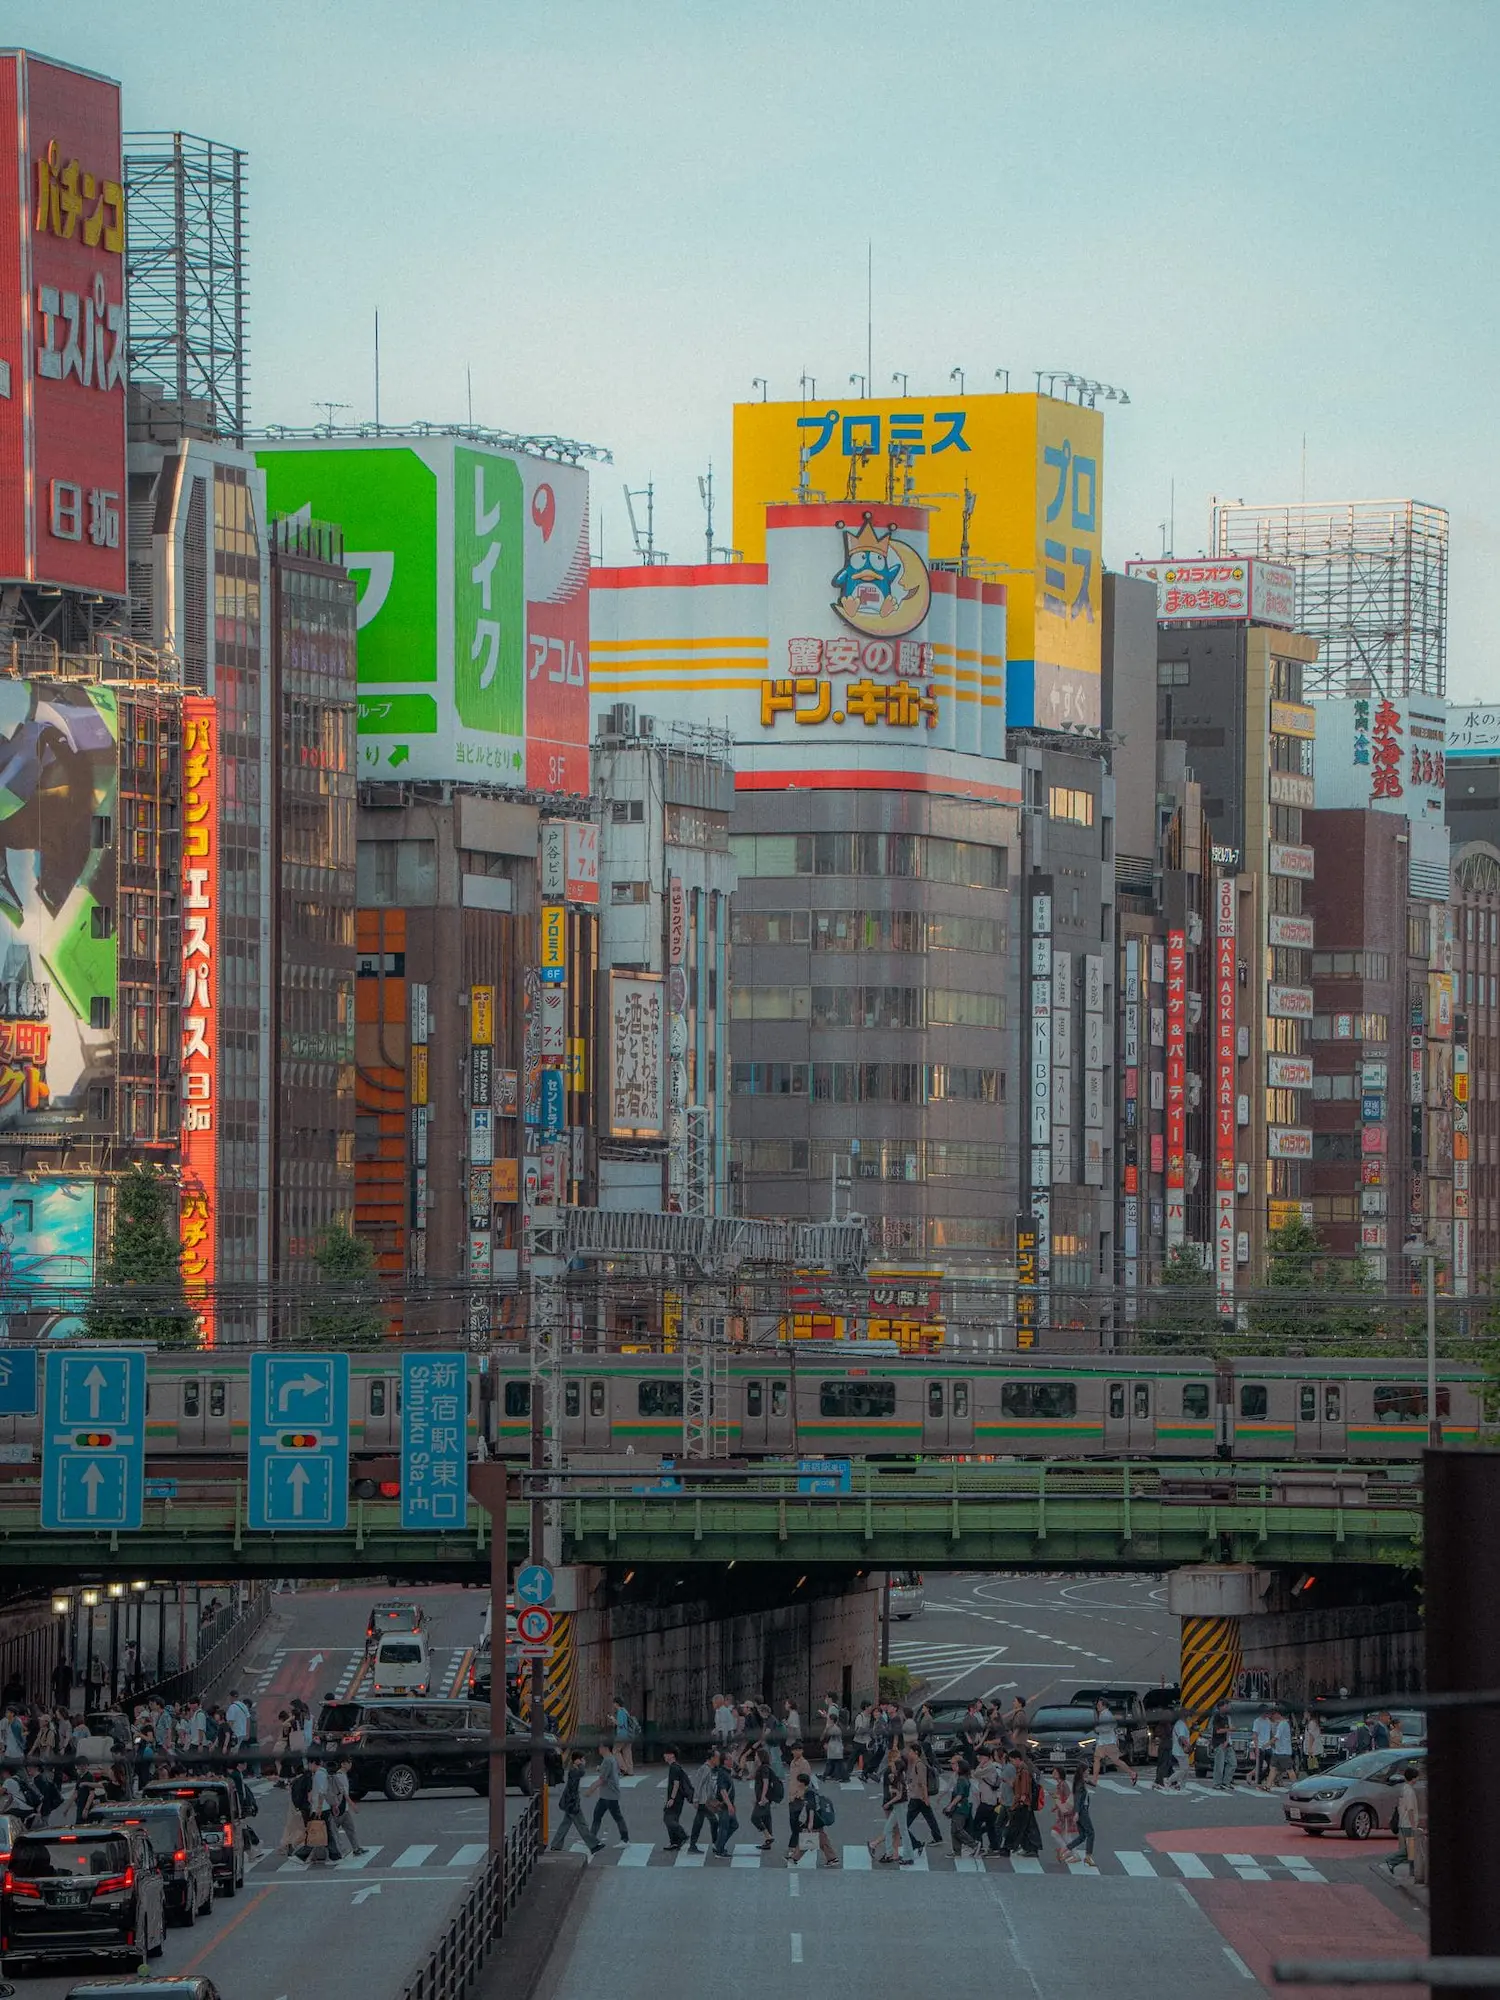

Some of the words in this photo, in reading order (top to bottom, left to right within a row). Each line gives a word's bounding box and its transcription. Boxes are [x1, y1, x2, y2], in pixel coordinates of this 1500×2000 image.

[36, 139, 124, 253] パチンコ
[37, 272, 126, 391] エスパス
[796, 409, 972, 457] プロミス
[1044, 439, 1096, 532] プロ
[49, 478, 119, 549] 日拓
[472, 465, 502, 690] レイク
[1043, 538, 1095, 623] ミス
[1165, 588, 1243, 613] まねきねこ
[1175, 566, 1233, 582] カラオケ
[529, 634, 585, 687] アコム
[1463, 711, 1500, 728] 水の
[548, 755, 566, 785] 3F
[1370, 699, 1404, 799] 東海苑
[1270, 776, 1313, 804] DARTS
[547, 831, 561, 888] 戸谷ビル
[1221, 881, 1232, 919] 300
[547, 912, 560, 961] プロミス
[1219, 925, 1233, 933] OK
[547, 969, 560, 978] 6F
[1221, 937, 1232, 1037] KARAOKE
[480, 1050, 488, 1071] BUZZ
[1221, 1047, 1232, 1056] &
[480, 1074, 488, 1102] STAND
[1035, 1022, 1047, 1139] KIBORI
[1221, 1066, 1232, 1135] PARTY
[472, 1216, 488, 1227] 7F
[1219, 1198, 1232, 1313] PASELA
[405, 1366, 430, 1444] Shinjuku
[430, 1361, 459, 1518] 新宿駅東口
